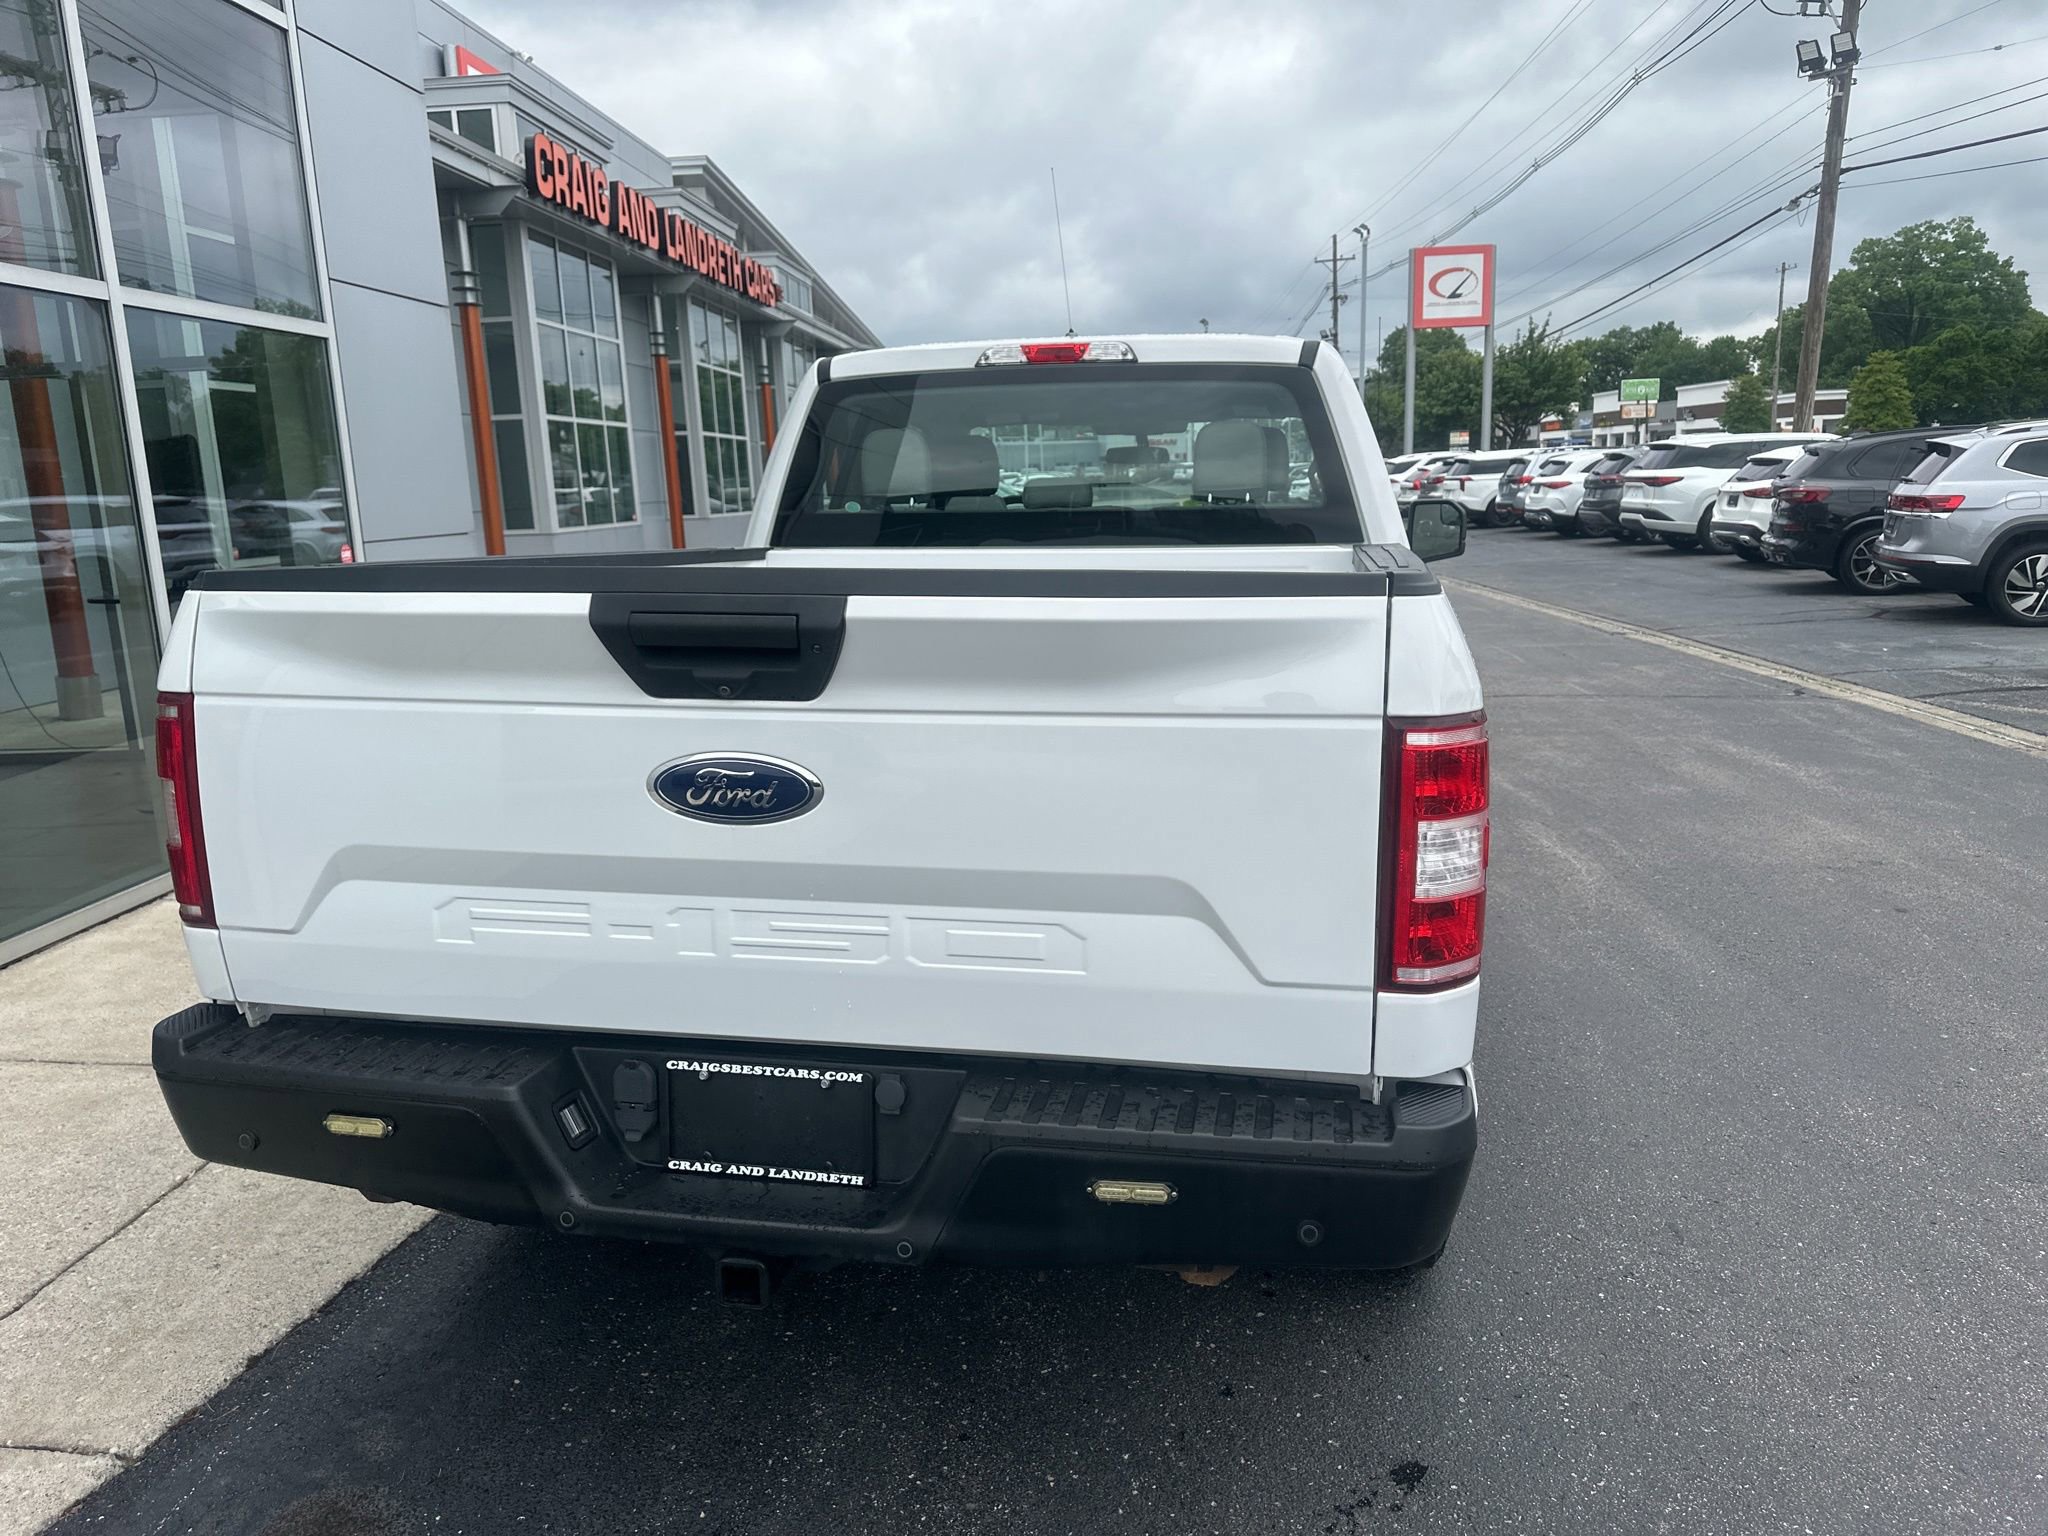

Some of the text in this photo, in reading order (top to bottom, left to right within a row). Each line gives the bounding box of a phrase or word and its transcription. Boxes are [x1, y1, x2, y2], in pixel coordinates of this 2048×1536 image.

[533, 132, 776, 308] CRAIG AND LANDRETH CARS
[686, 767, 779, 809] Ford
[434, 896, 1087, 974] F-150
[665, 1060, 863, 1083] CRAIGSBESTCARS.COM
[667, 1160, 864, 1186] CRAIG AND LANDRETH
